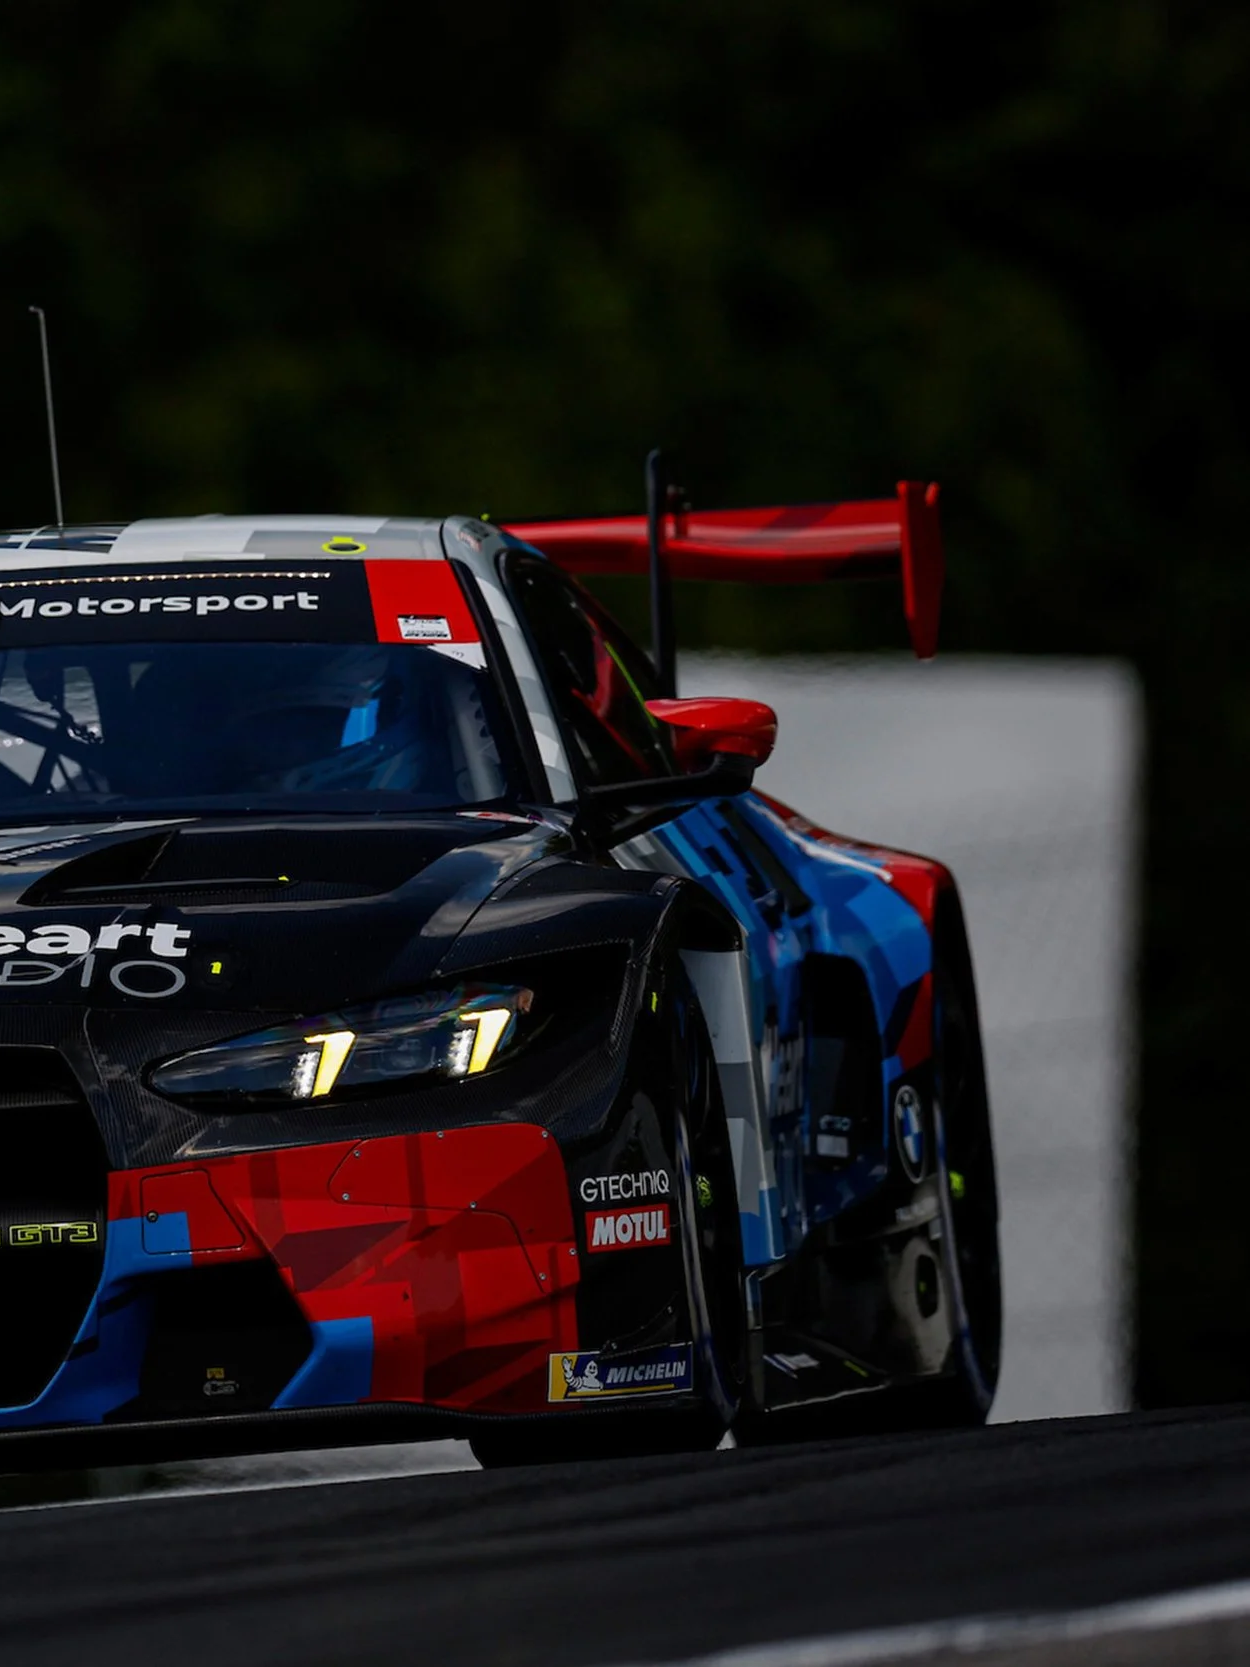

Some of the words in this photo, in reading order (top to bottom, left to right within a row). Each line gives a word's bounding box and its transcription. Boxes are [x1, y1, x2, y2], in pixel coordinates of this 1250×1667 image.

[8, 1220, 99, 1247] GT3
[591, 1209, 669, 1247] MOTUL
[605, 1359, 687, 1385] MICHELIN
